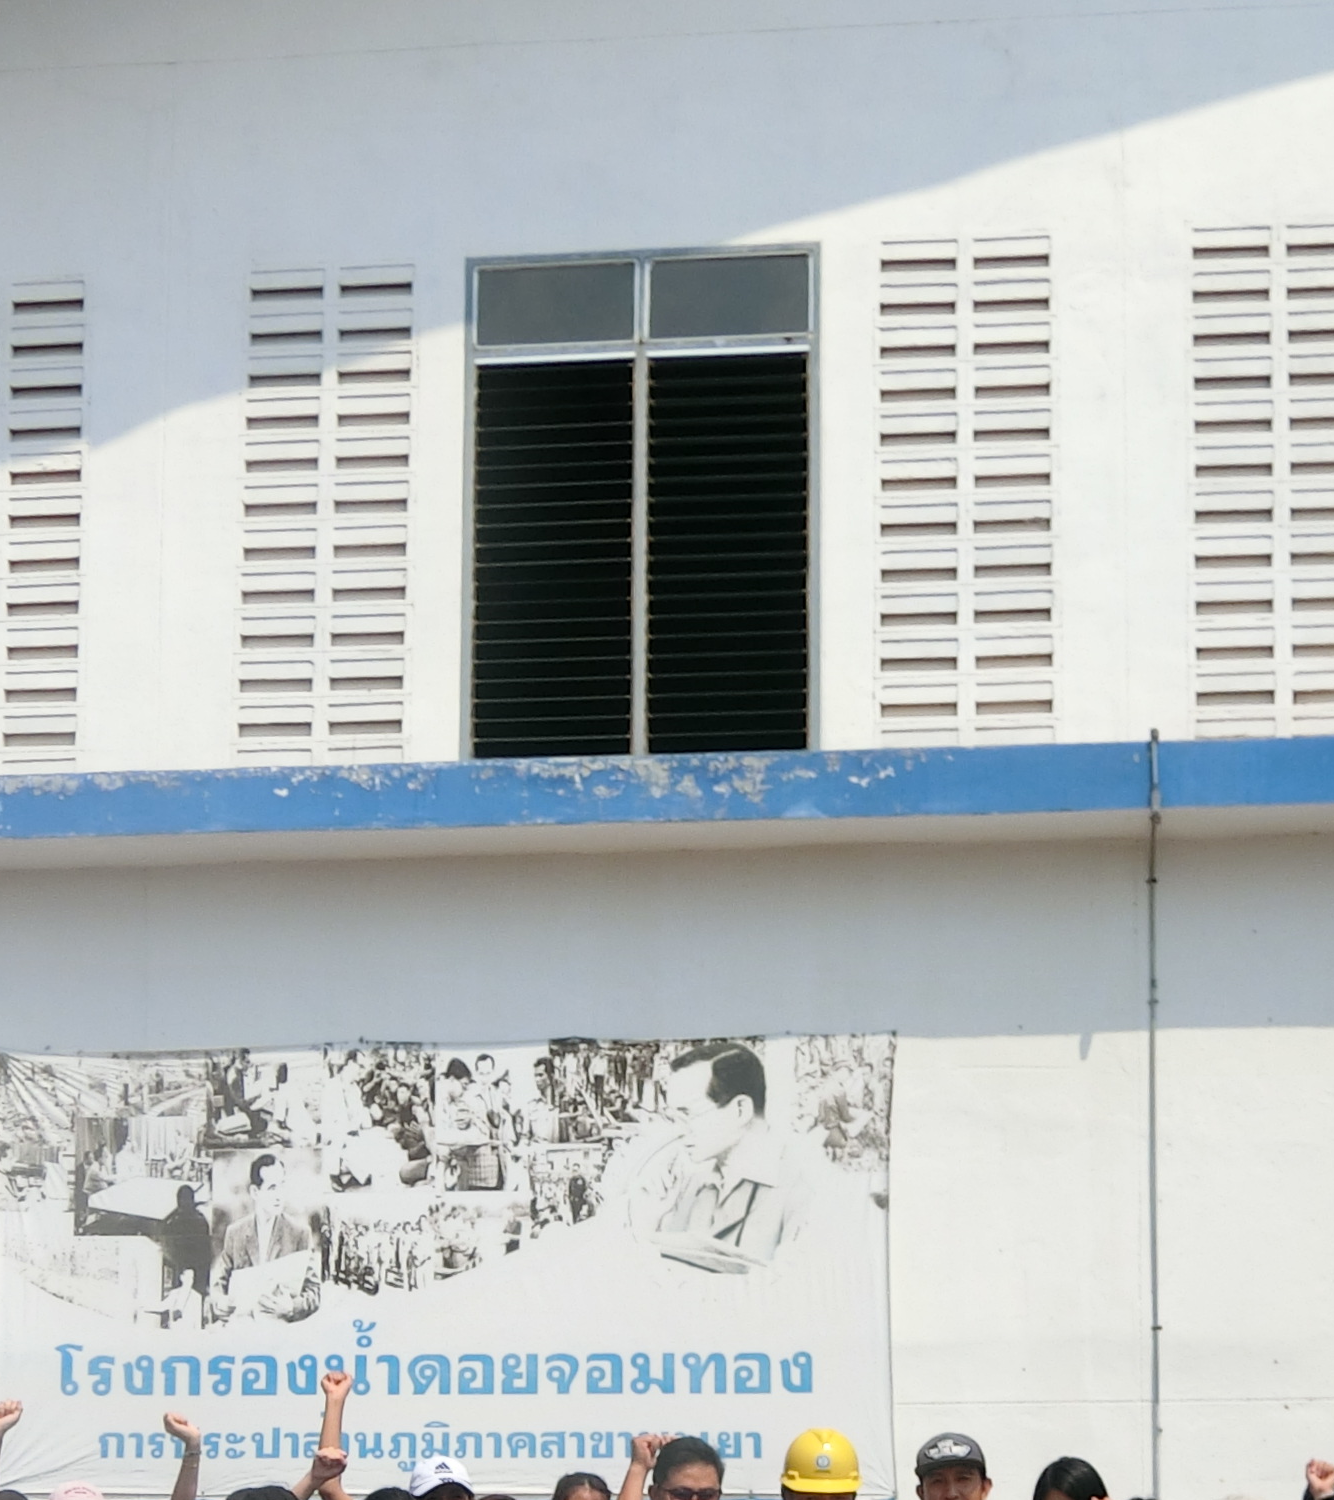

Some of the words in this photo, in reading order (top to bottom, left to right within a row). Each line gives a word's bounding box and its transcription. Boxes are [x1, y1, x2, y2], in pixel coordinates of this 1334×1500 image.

[57, 1318, 814, 1397] โรงกรองน้ำดอยจอมทอง
